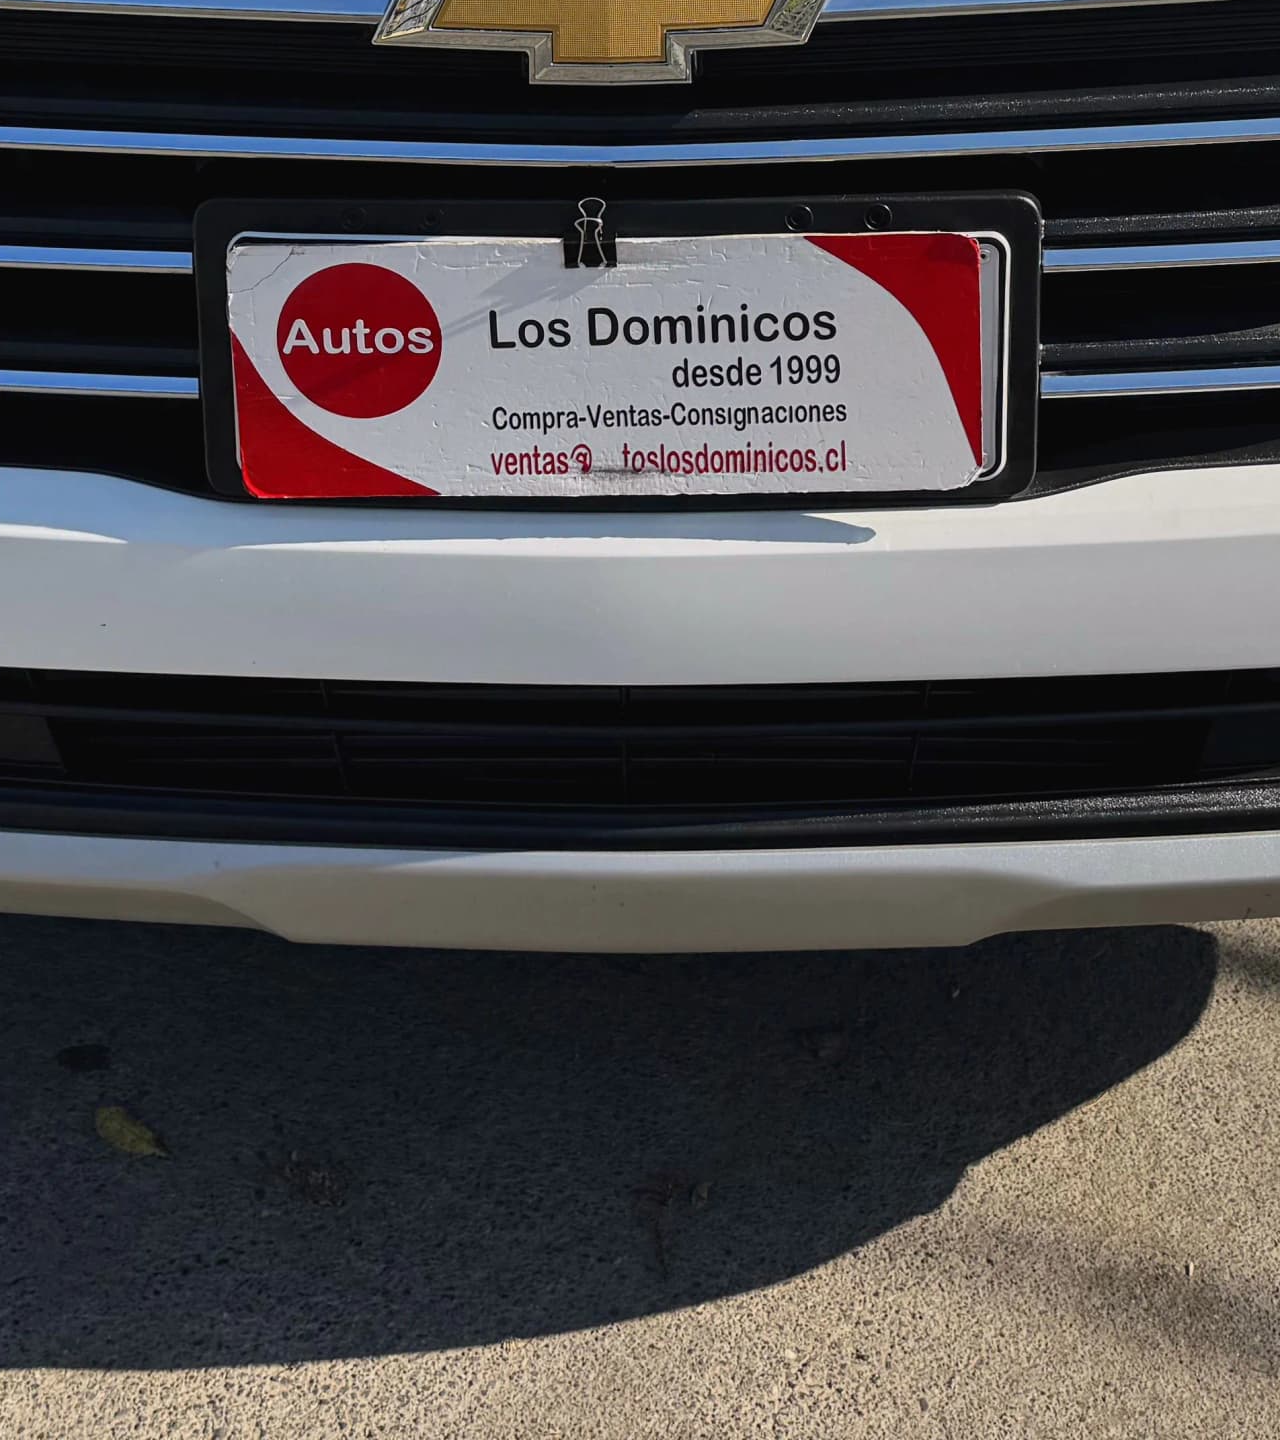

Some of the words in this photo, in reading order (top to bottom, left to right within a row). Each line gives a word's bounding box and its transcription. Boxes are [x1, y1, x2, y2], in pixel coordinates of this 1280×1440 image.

[282, 318, 434, 355] Autos
[488, 309, 572, 349] Los
[587, 303, 837, 347] Dominicos
[672, 356, 763, 388] desde
[769, 354, 841, 386] 1999
[492, 401, 848, 435] Compra-Ventas-Consignaciones
